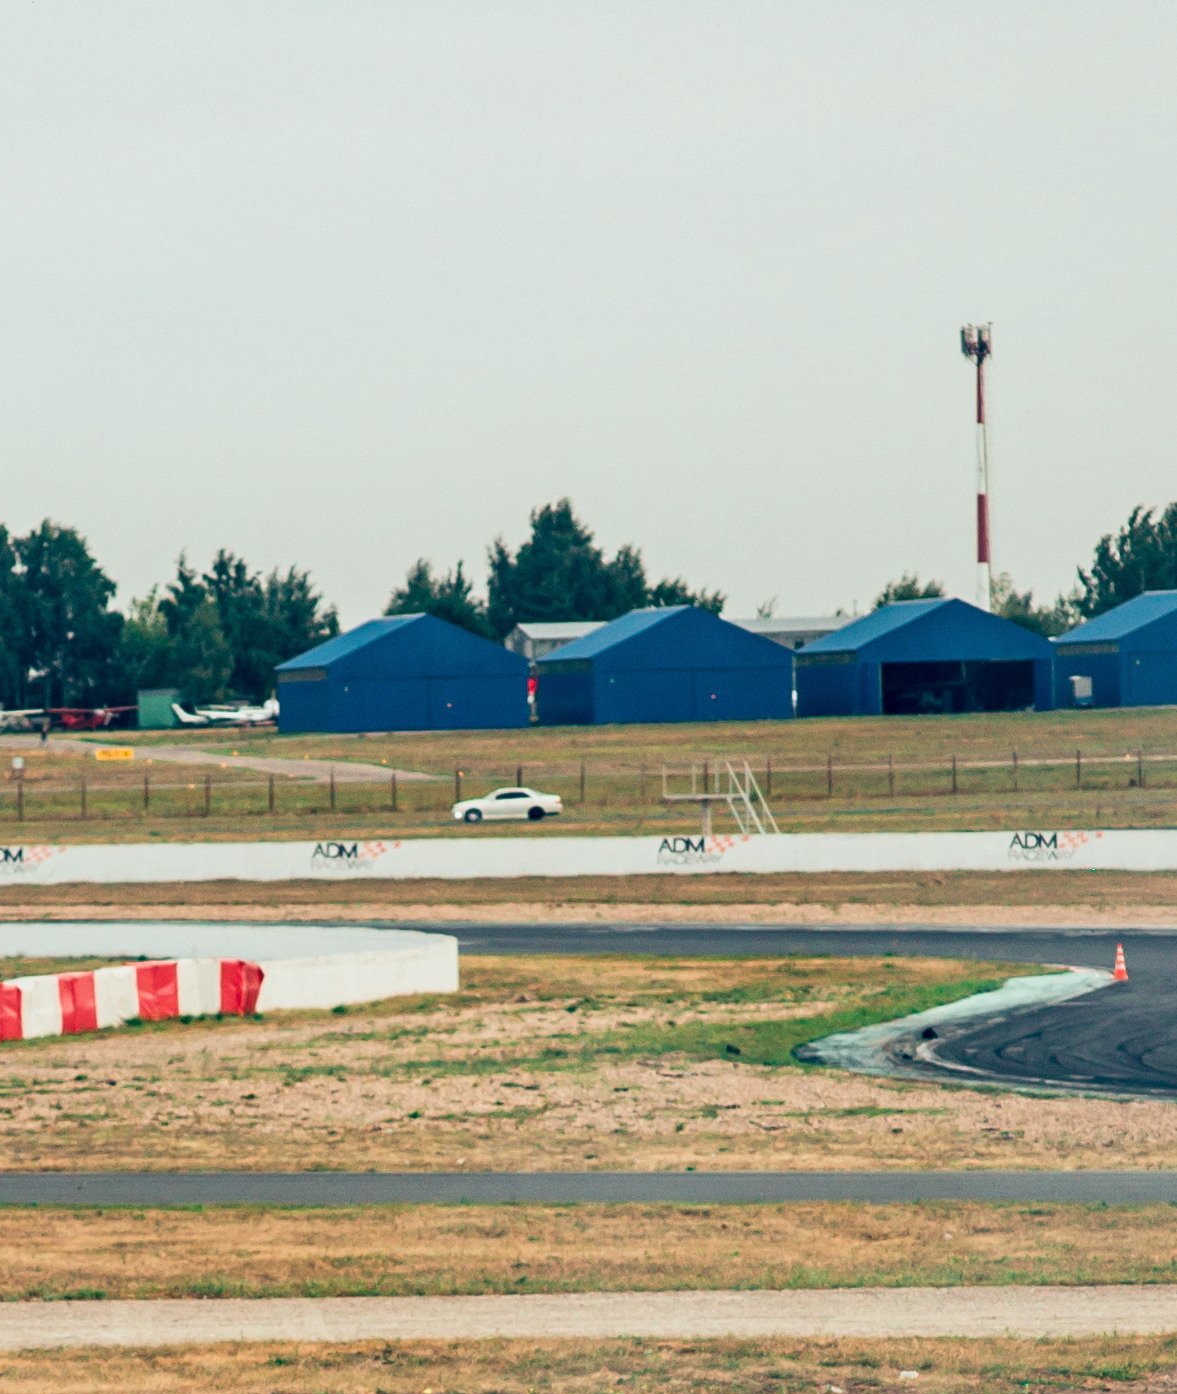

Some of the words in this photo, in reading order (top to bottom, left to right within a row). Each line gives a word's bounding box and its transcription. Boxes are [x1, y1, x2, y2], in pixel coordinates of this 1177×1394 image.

[658, 837, 705, 853] ADM
[1009, 832, 1058, 849] ADM
[311, 843, 358, 858] ADM
